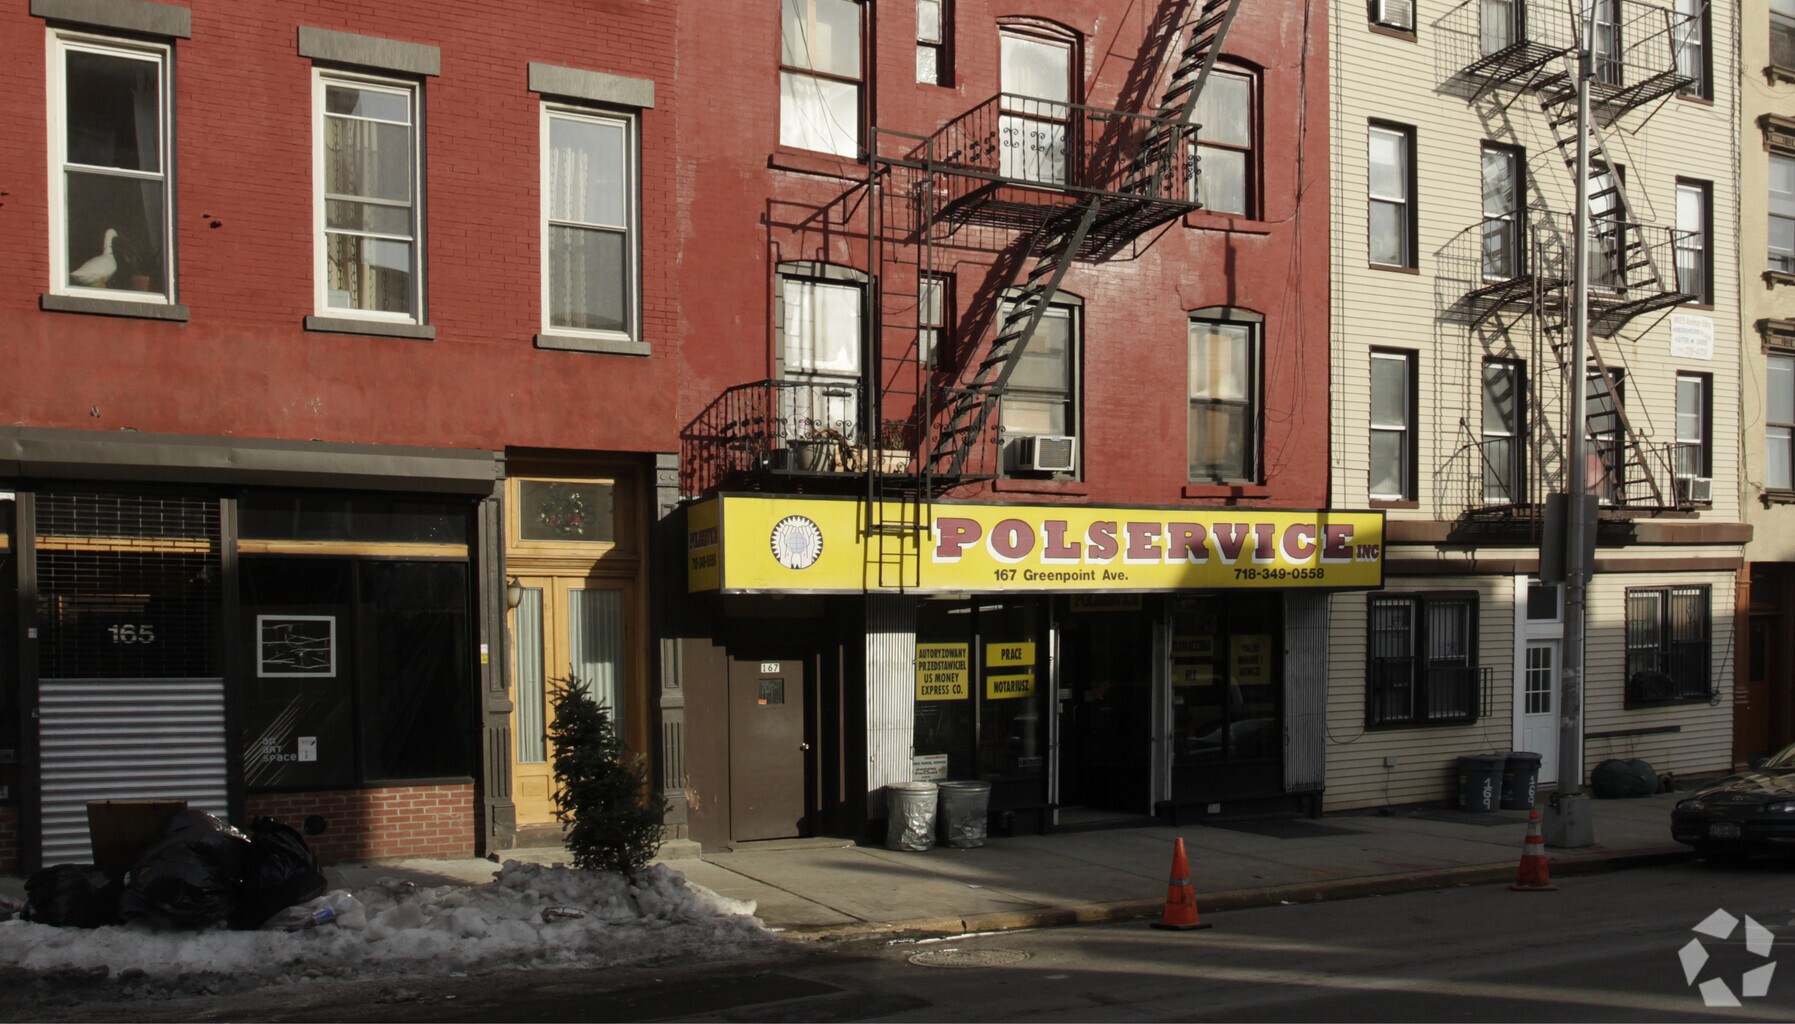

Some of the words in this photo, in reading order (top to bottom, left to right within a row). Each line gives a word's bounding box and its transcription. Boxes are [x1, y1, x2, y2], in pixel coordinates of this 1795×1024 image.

[932, 517, 1354, 564] POLSERVICE
[1355, 544, 1380, 562] INC
[994, 569, 1017, 581] 167
[1023, 569, 1096, 583] Greenpoint
[1102, 569, 1129, 581] Ave.
[1234, 568, 1325, 580] 718-349-0558
[107, 624, 155, 644] 165
[919, 648, 967, 659] AUTORYZOWANY
[1001, 648, 1022, 661] PRACE
[762, 664, 778, 672] 167
[918, 660, 966, 671] PRZEDSTAWICIEL
[924, 673, 933, 683] US
[935, 673, 959, 683] MONEY
[921, 684, 949, 695] EXPRESS
[952, 684, 963, 695] CO.
[994, 680, 1029, 693] NOTARIUSZ
